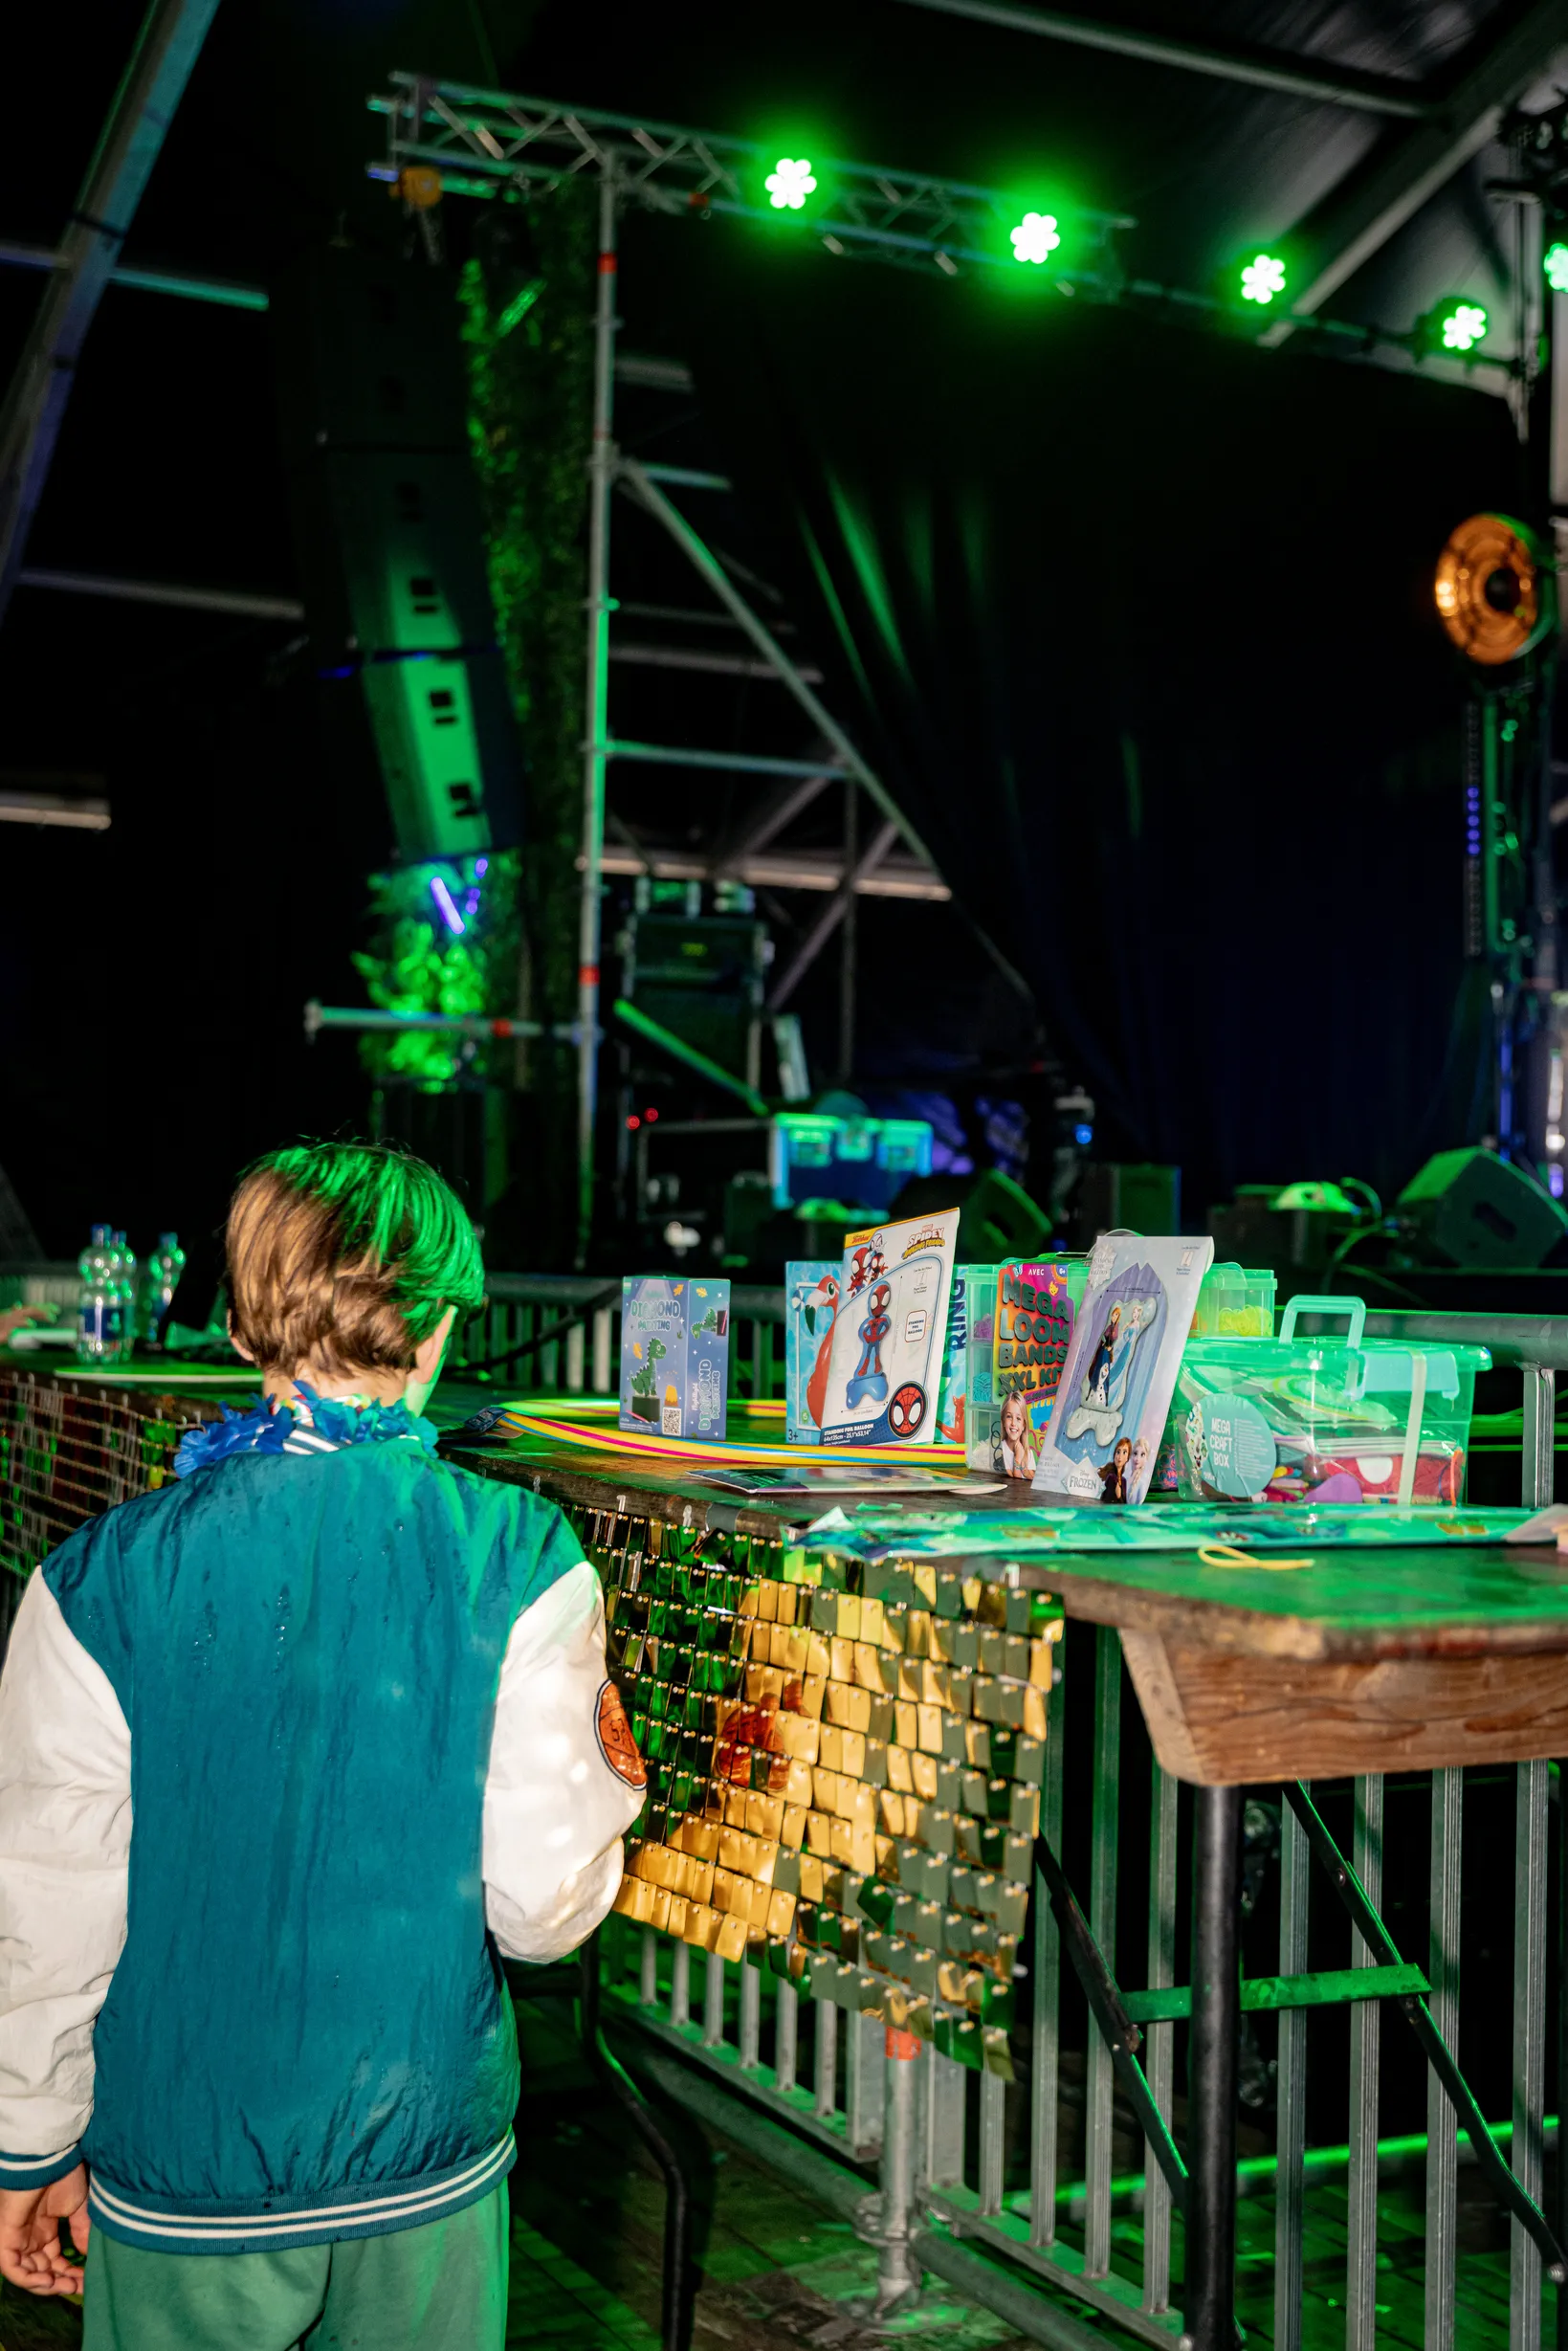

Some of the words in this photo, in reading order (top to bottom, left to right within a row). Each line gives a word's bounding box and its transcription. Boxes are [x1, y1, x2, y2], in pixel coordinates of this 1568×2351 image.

[908, 1228, 945, 1248] SPIDEY
[1002, 1274, 1070, 1322] MEGA
[630, 1299, 681, 1318] DIAMOND
[947, 1278, 966, 1351] RING
[637, 1320, 671, 1331] PAINTING
[1000, 1308, 1070, 1344] LOOM
[998, 1343, 1069, 1368] BANDS
[998, 1370, 1036, 1396] XXL
[698, 1359, 712, 1431] DIAMOND
[788, 1430, 798, 1441] 3+
[824, 1427, 844, 1435] STANDING
[854, 1423, 874, 1431] BALLOON
[1211, 1417, 1231, 1435] MEGA
[1209, 1435, 1232, 1453] CRAFT
[1213, 1452, 1230, 1469] BOX
[1069, 1475, 1097, 1491] FROZEN
